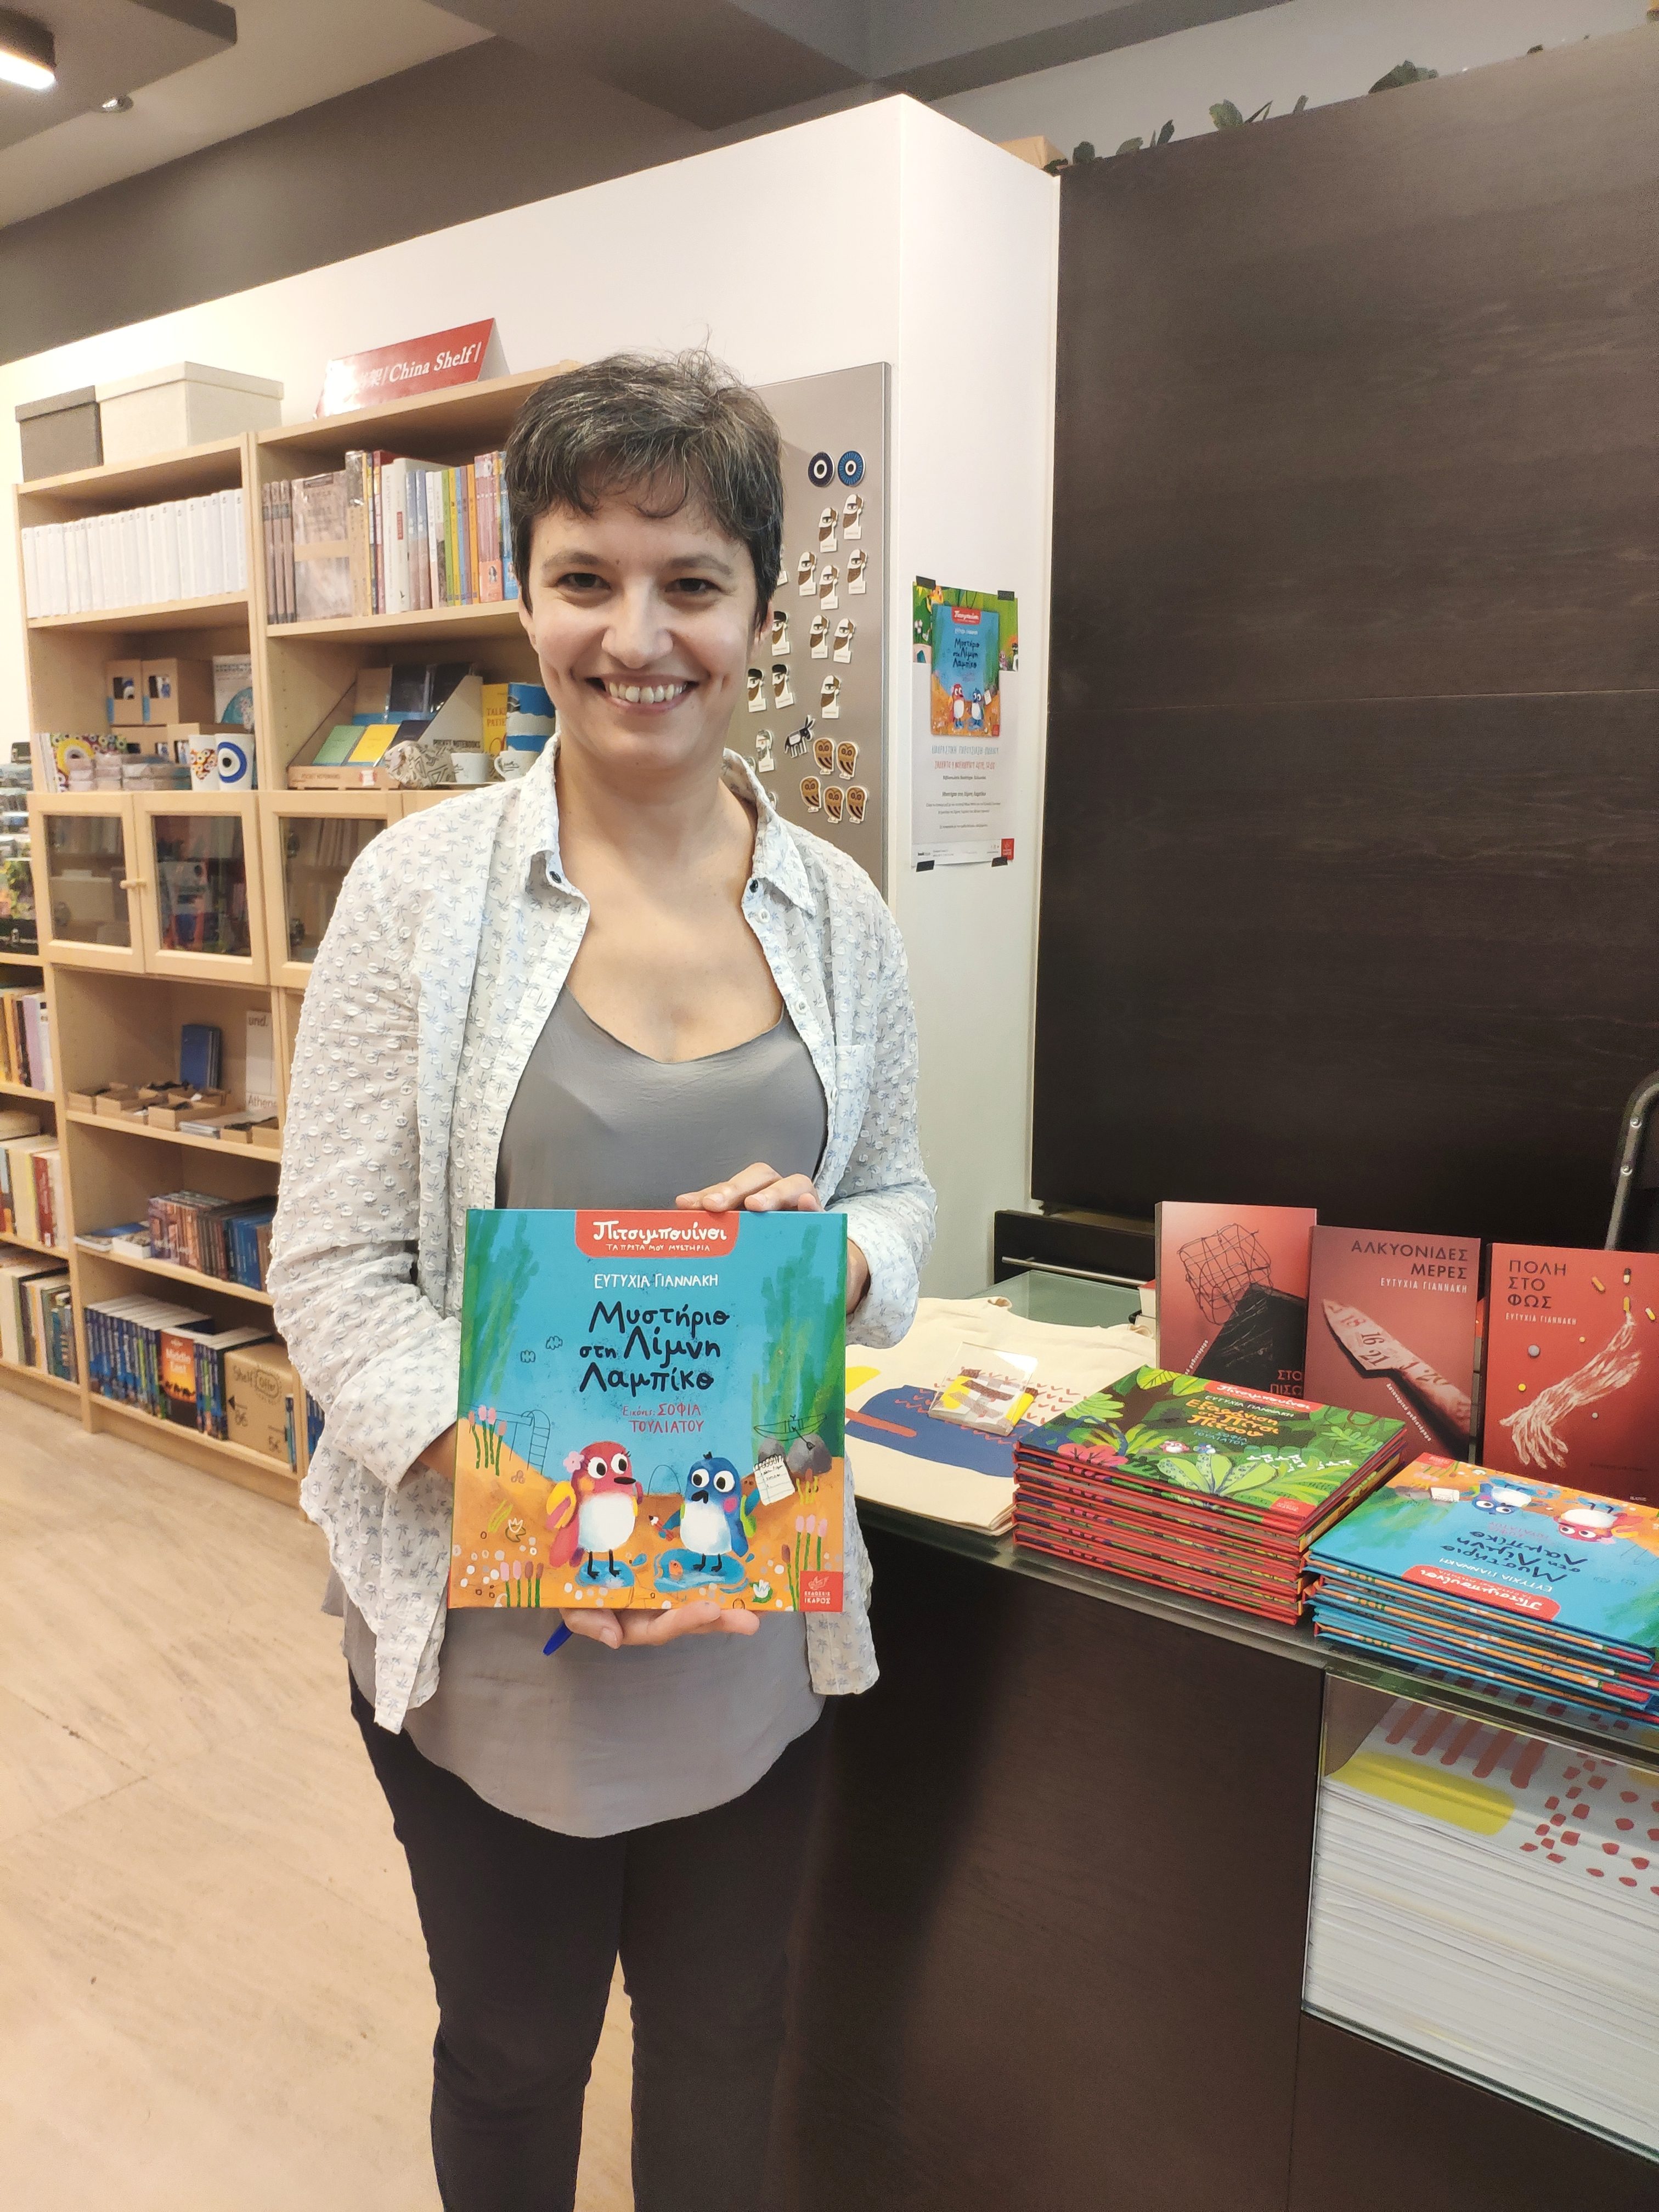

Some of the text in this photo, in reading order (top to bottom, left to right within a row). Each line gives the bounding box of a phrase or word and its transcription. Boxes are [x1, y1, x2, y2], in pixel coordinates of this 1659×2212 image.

[592, 1220, 727, 1245] Πιτσιμπουίνοι
[1351, 1240, 1468, 1261] ΑΛΚΥΟΝΙΔΕΣ
[1411, 1263, 1467, 1279] ΜΕΡΕΣ
[1509, 1260, 1566, 1276] ΠΟΛΗ
[594, 1273, 719, 1289] ΕΥΤΥΧΙΑ ΓΙΑΝΝΑΚΗ
[1380, 1277, 1467, 1294] ΕΥΤΥΧΙΑ ΓΙΑΝΝΑΚΗ
[1508, 1276, 1545, 1291] ΣΤΟ
[1508, 1294, 1551, 1309] ΦΩΣ
[589, 1301, 730, 1339] Μυστήριο
[1505, 1312, 1577, 1325] ΕΥΤΥΧΙΑ ΓΙΑΝΝΑΚΗ
[579, 1325, 721, 1369] στη Λίμνη
[579, 1362, 714, 1397] Λαμπίκο
[1277, 1369, 1302, 1381] ΣΤΟ
[1269, 1384, 1302, 1396] ΠΙΣΩ
[657, 1402, 701, 1417] ΣΟΦΙΑ
[628, 1420, 704, 1434] ΤΟΥΛΙΑΤΟΥ
[1502, 1574, 1553, 1593] ΕΥΤΥΧΙΑ
